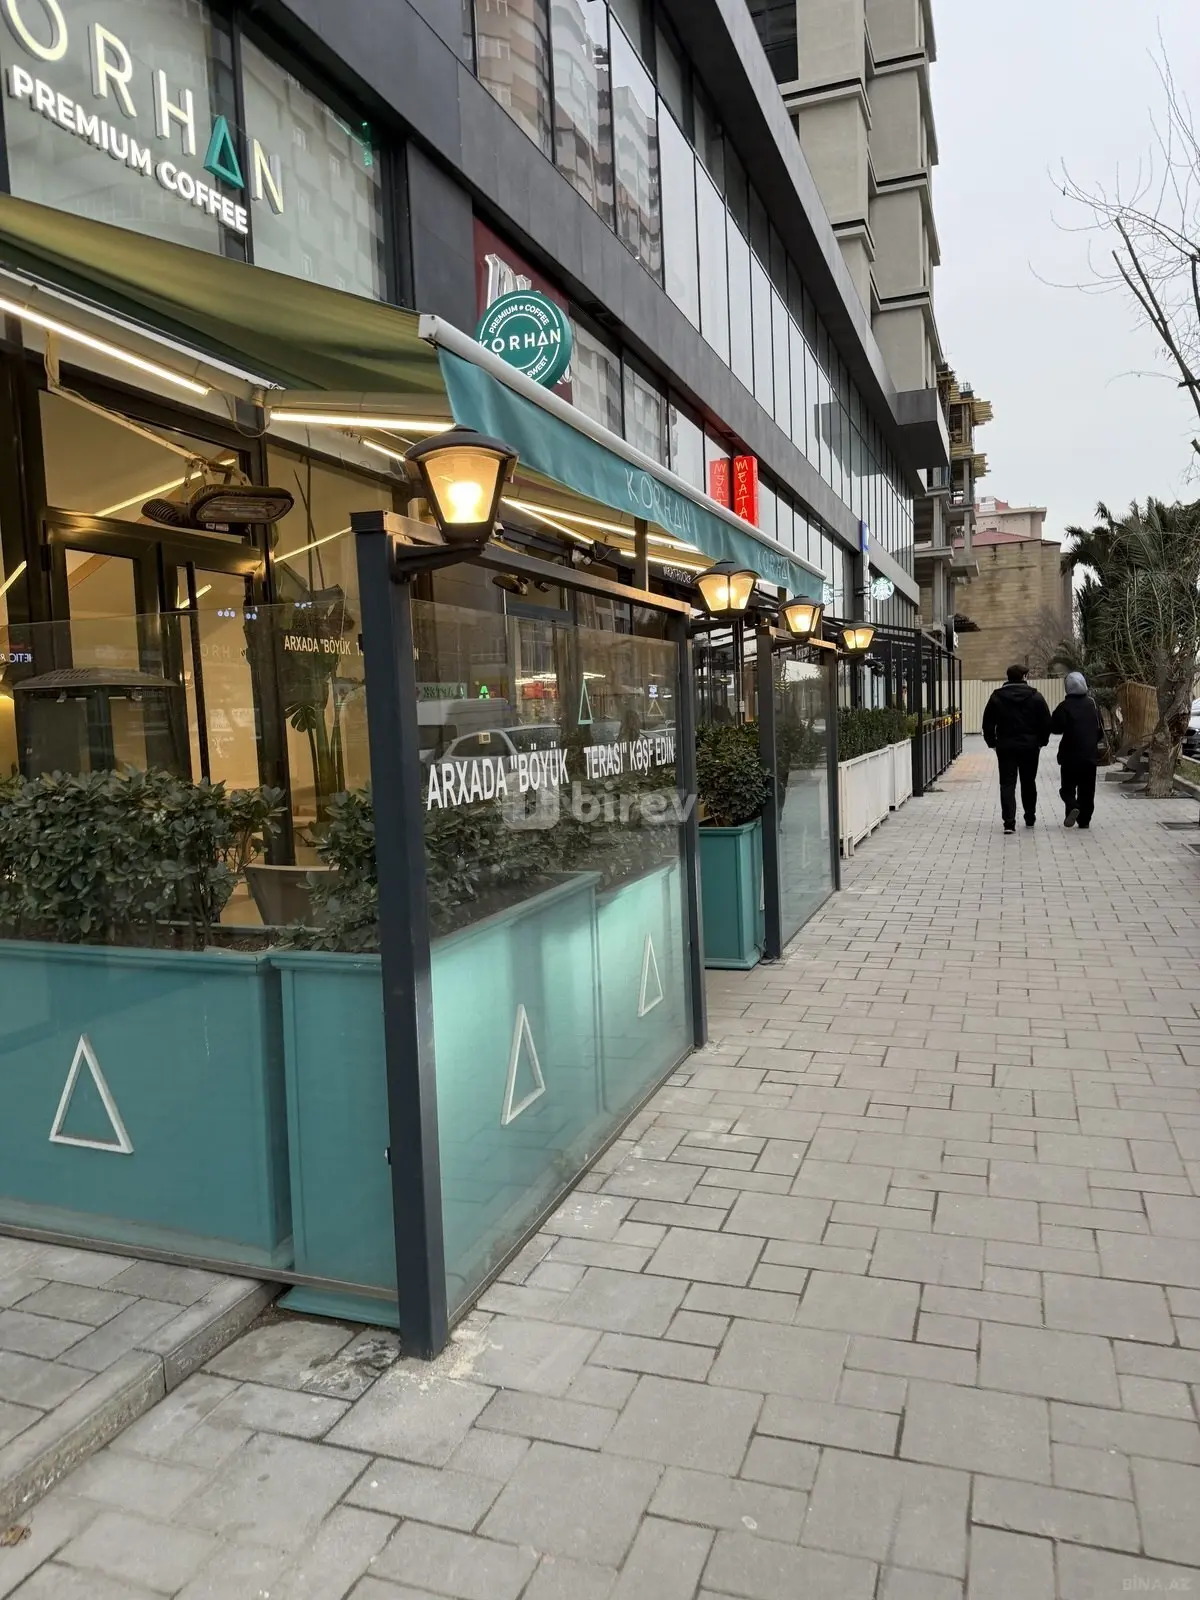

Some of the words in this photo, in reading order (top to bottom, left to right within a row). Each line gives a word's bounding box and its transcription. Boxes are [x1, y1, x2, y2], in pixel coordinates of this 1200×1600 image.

[7, 64, 152, 177] PREMIUM
[155, 160, 248, 235] COFFEE
[488, 304, 518, 334] PREMIUM
[524, 303, 550, 326] COFFEE
[526, 355, 548, 378] SWEET
[284, 635, 319, 653] ARXADA
[426, 757, 508, 811] ARXADA
